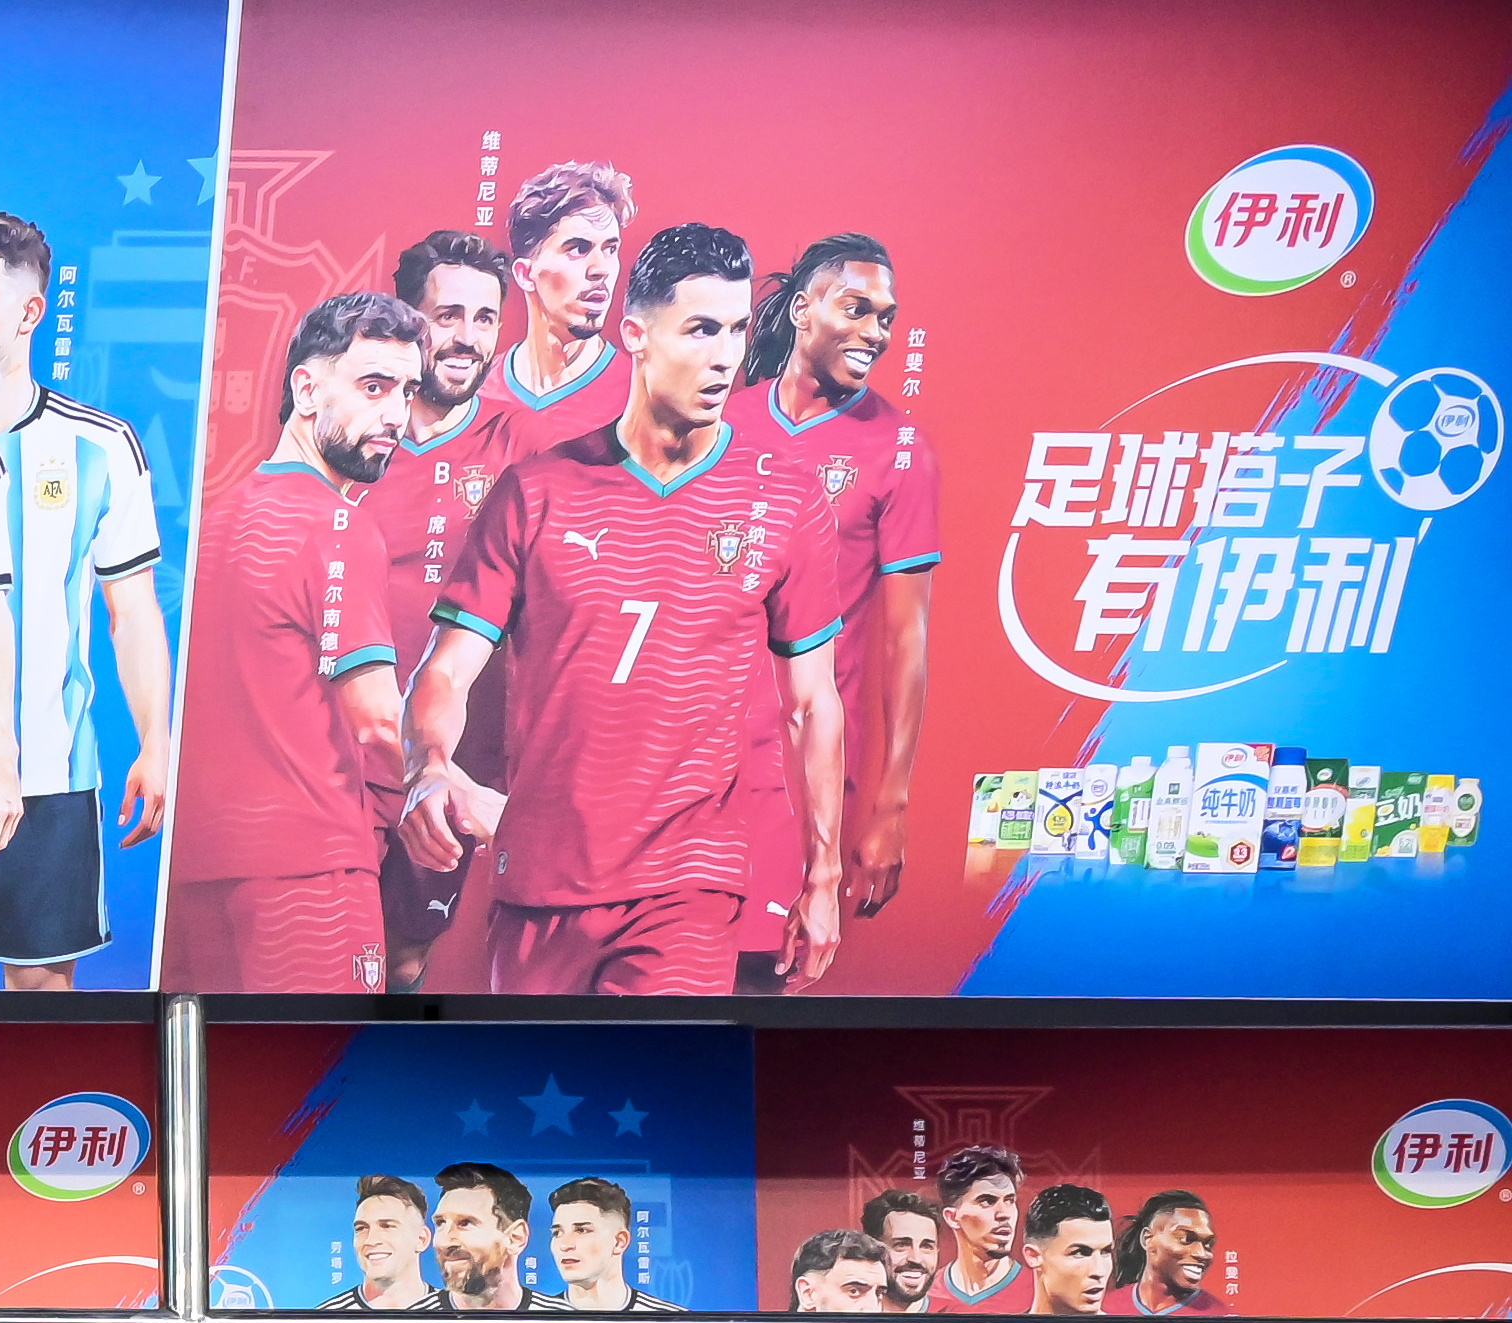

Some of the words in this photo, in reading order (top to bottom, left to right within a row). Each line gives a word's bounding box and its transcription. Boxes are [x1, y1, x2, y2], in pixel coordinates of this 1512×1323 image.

[475, 130, 501, 229] 维蒂尼亚
[51, 265, 77, 382] 阿尔瓦雷斯
[1012, 432, 1361, 529] 足球搭子
[28, 1127, 126, 1169] 伊利
[1393, 1132, 1495, 1174] 伊利
[636, 1210, 651, 1285] 阿尔瓦雷斯
